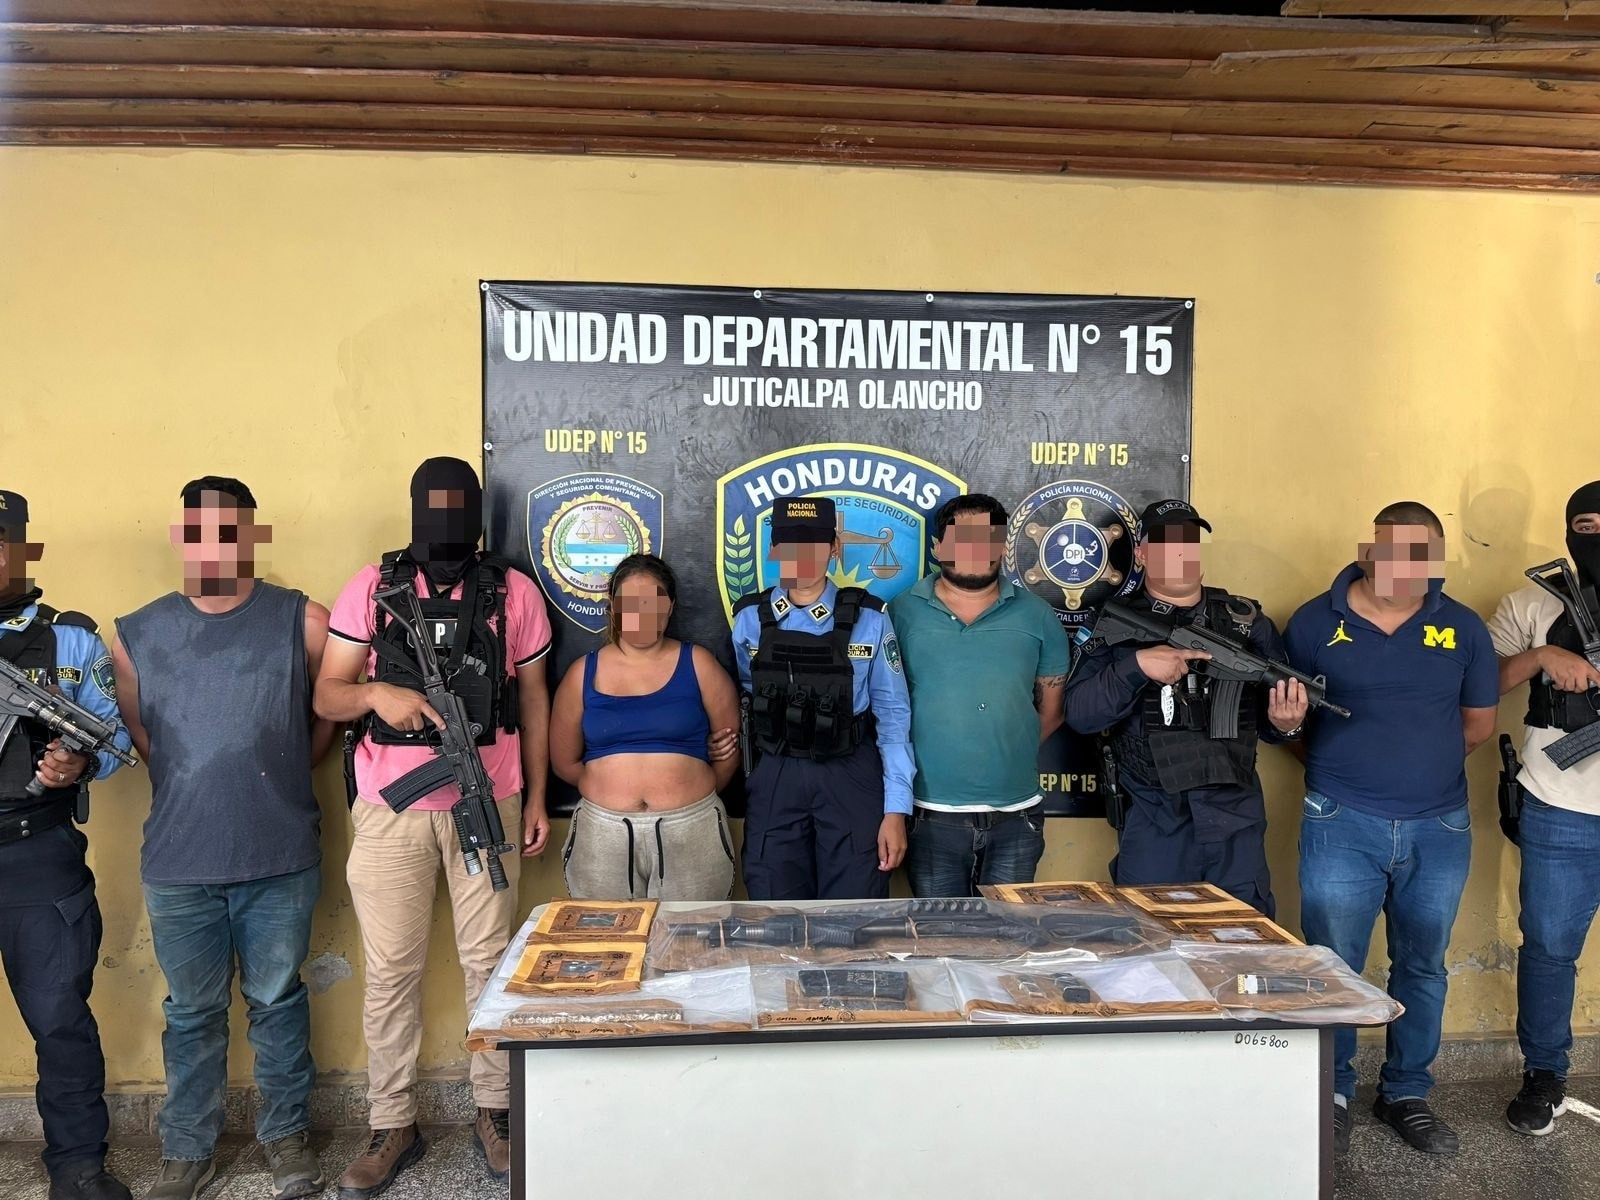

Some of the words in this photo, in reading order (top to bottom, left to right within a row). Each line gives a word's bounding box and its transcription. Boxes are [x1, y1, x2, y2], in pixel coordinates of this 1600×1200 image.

[504, 310, 667, 364] UNIDAD
[683, 314, 1034, 372] DEPARTAMENTAL
[1119, 325, 1173, 375] 15
[703, 376, 849, 408] JUTICALPA
[858, 379, 982, 411] OLANCHO
[545, 429, 596, 453] UDEP
[627, 431, 647, 454] 15
[1031, 442, 1080, 465] UDEP
[1109, 443, 1129, 466] 15
[534, 480, 569, 500] DIRECCIÓN
[569, 477, 603, 486] NACIONAL
[615, 479, 656, 500] PREVENCIÓN
[556, 484, 594, 497] SEGURIDAD
[595, 484, 641, 499] COMUNITARIA
[744, 458, 941, 510] HONDURAS
[1039, 484, 1071, 501] POLICÍA
[1072, 485, 1113, 504] NACIONAL
[582, 505, 613, 513] PREVENIR
[786, 509, 818, 518] NACIONAL
[787, 502, 816, 510] POLICIA
[835, 496, 851, 507] DE
[854, 497, 918, 529] SEGURIDAD
[1065, 549, 1083, 559] DPI
[569, 576, 589, 588] SERVIR
[1073, 614, 1084, 622] DE
[1423, 625, 1457, 650] M
[1081, 774, 1097, 792] 15
